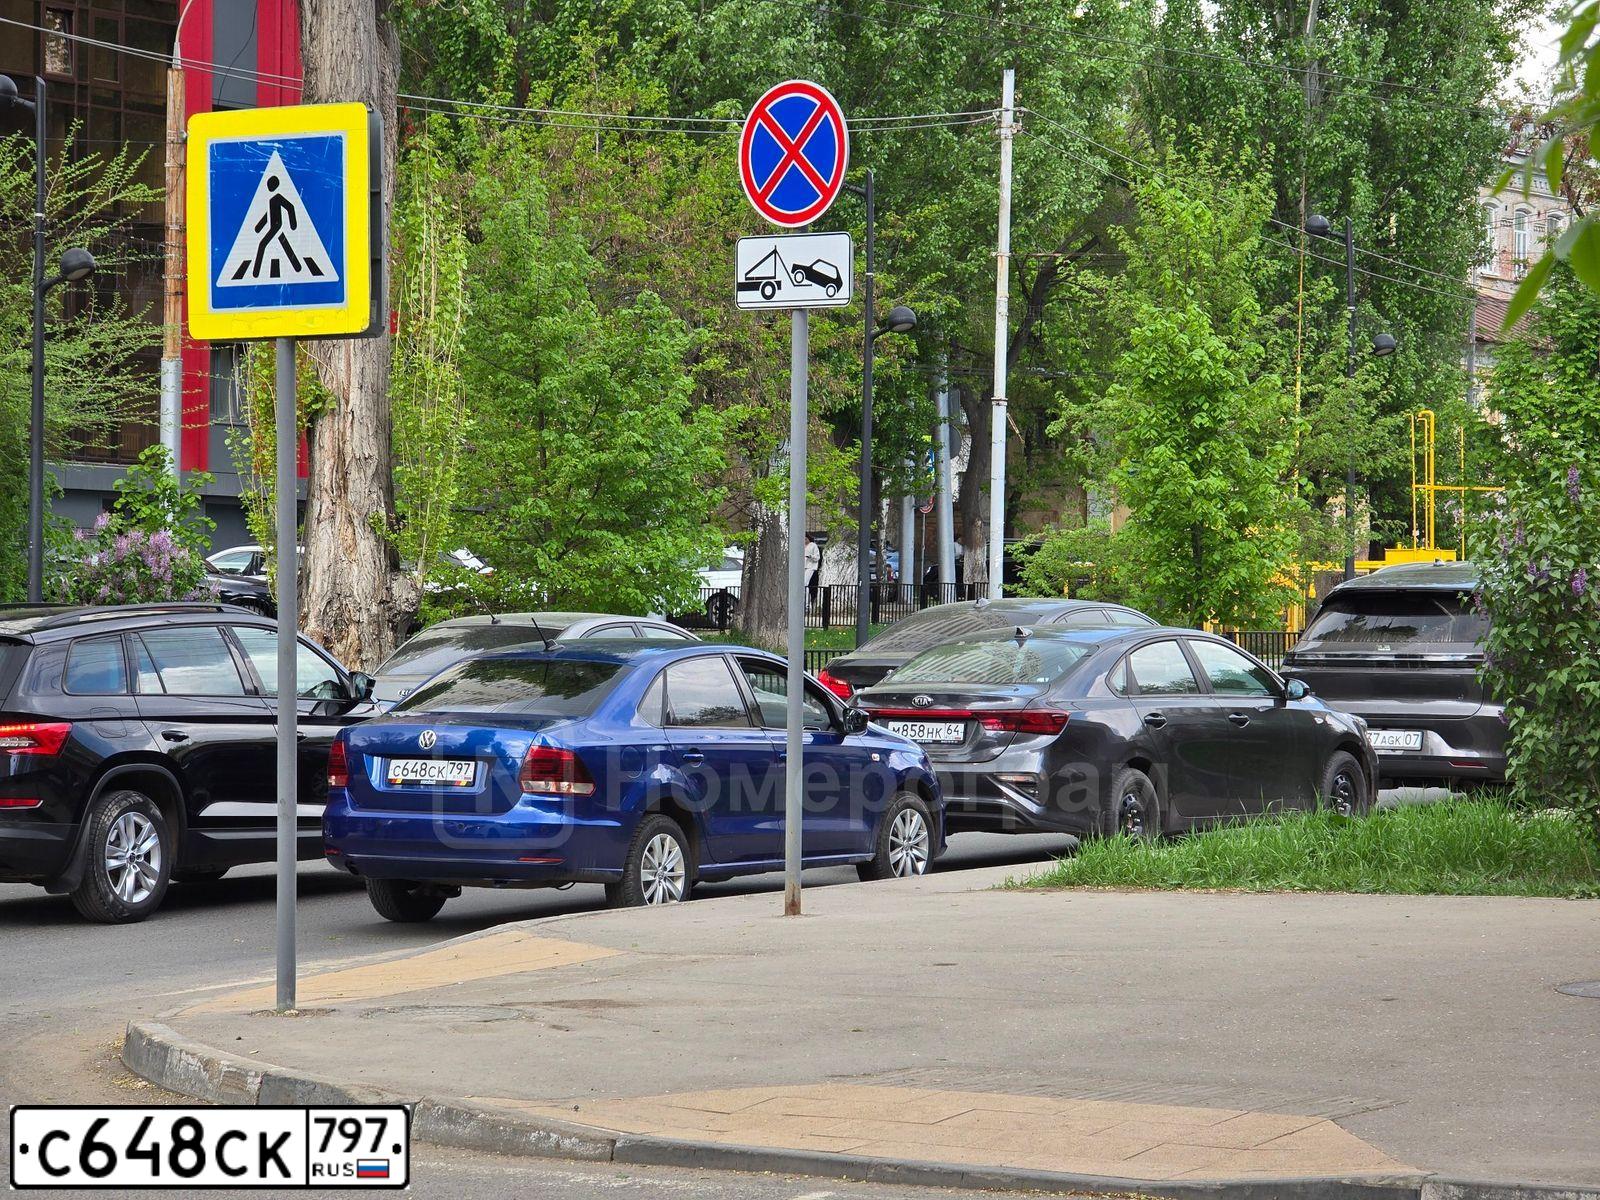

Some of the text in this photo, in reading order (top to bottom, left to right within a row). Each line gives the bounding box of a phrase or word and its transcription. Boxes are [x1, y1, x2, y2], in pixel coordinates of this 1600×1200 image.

[946, 724, 959, 735] 64
[1405, 733, 1419, 746] 07
[393, 762, 470, 778] С648СК 797
